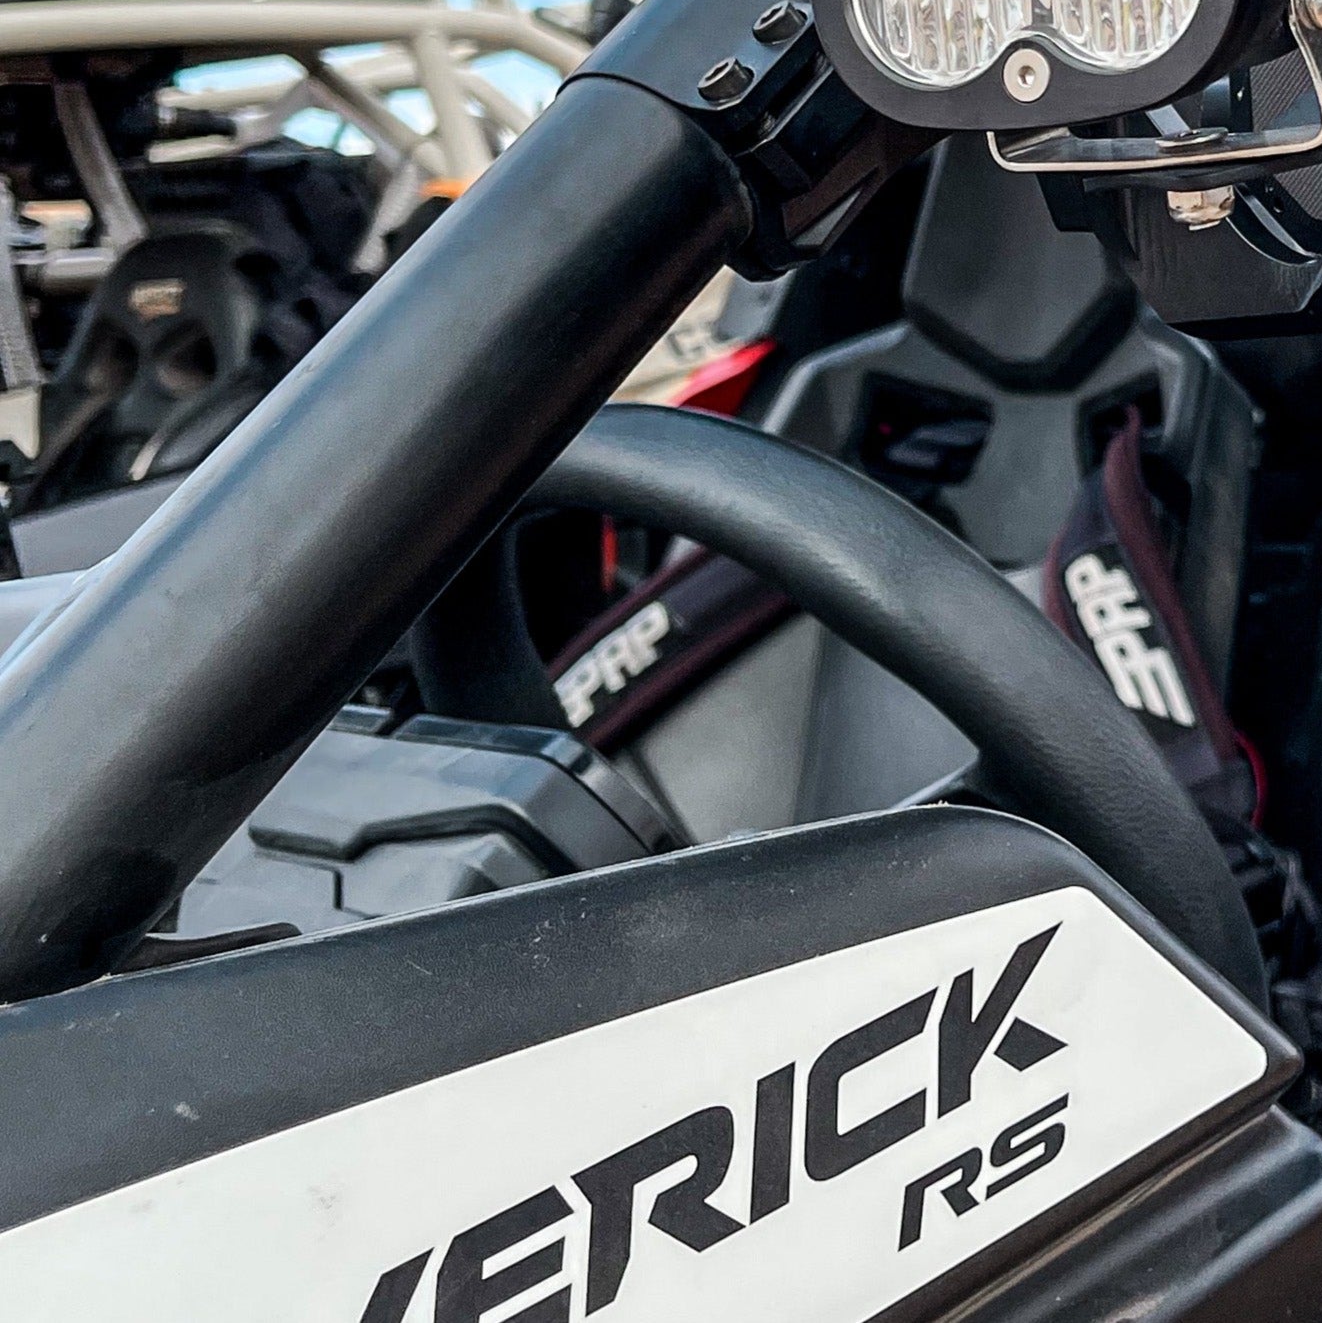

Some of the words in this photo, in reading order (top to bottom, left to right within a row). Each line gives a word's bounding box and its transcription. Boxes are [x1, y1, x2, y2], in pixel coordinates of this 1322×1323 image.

[553, 601, 670, 728] PRP
[1065, 553, 1196, 727] PRP
[898, 1093, 1069, 1253] RS
